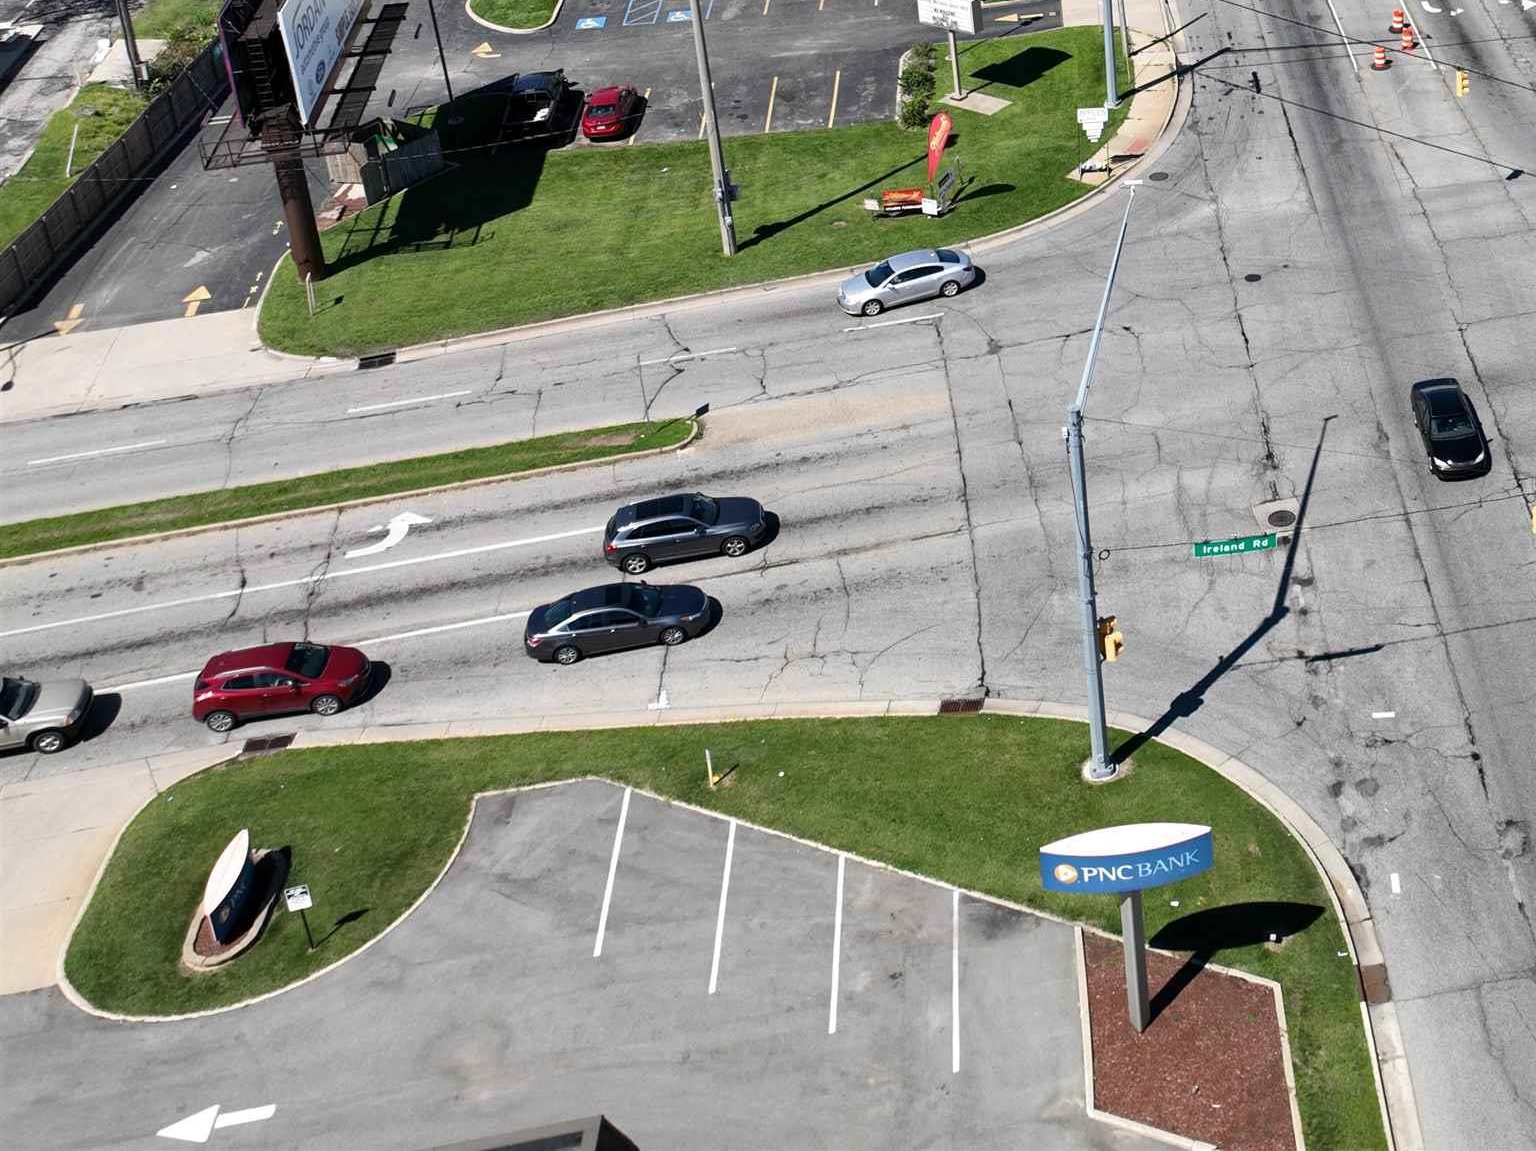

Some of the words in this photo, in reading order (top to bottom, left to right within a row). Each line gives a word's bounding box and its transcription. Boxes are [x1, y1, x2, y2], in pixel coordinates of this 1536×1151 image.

[1203, 542, 1245, 554] Ireland
[1252, 539, 1269, 548] Rd
[1080, 864, 1135, 883] PNC
[1135, 849, 1200, 877] BANK
